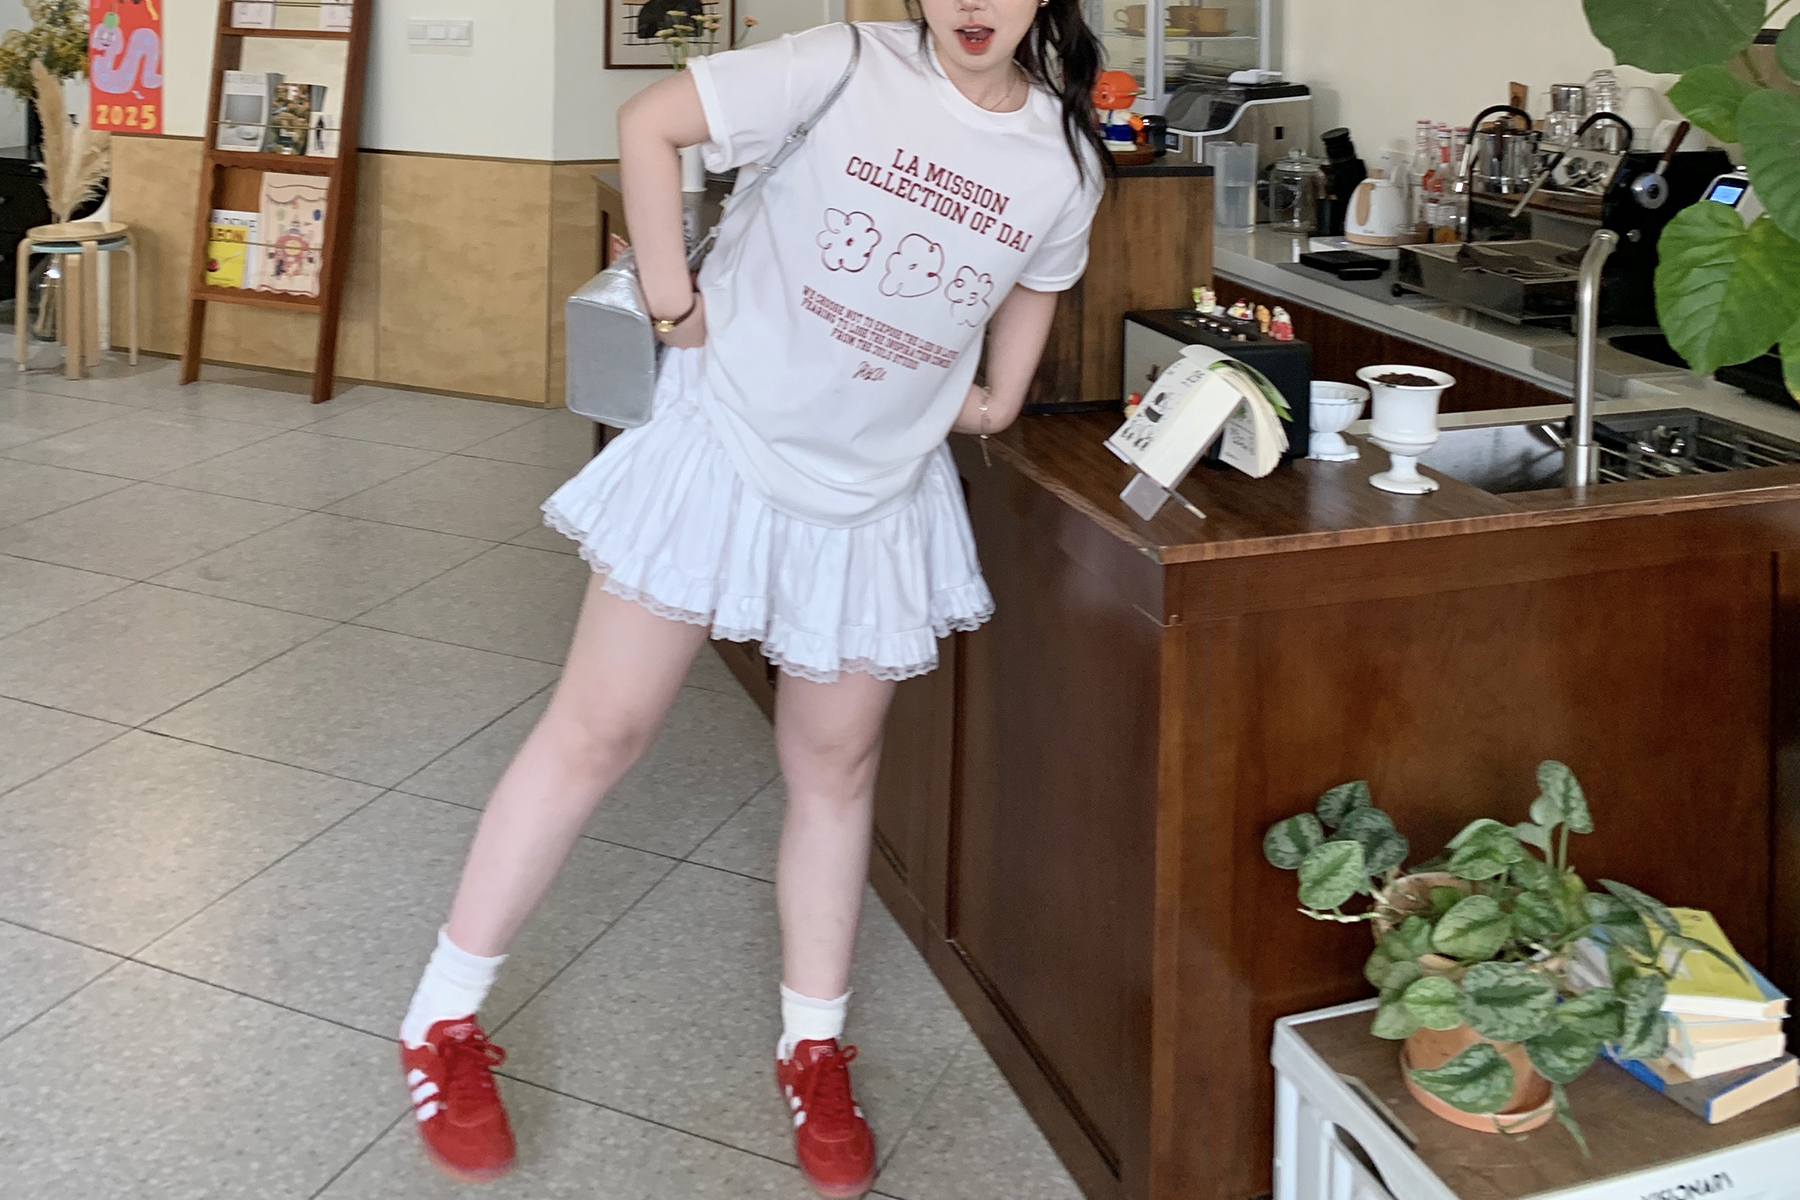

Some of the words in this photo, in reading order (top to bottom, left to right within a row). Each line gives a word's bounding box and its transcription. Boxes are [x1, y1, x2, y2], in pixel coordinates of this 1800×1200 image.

[96, 104, 157, 131] 2025
[845, 156, 970, 225] COLLECTION
[969, 211, 997, 236] OF
[995, 223, 1034, 253] DAI
[891, 148, 919, 178] LA
[923, 162, 1010, 216] MISSION
